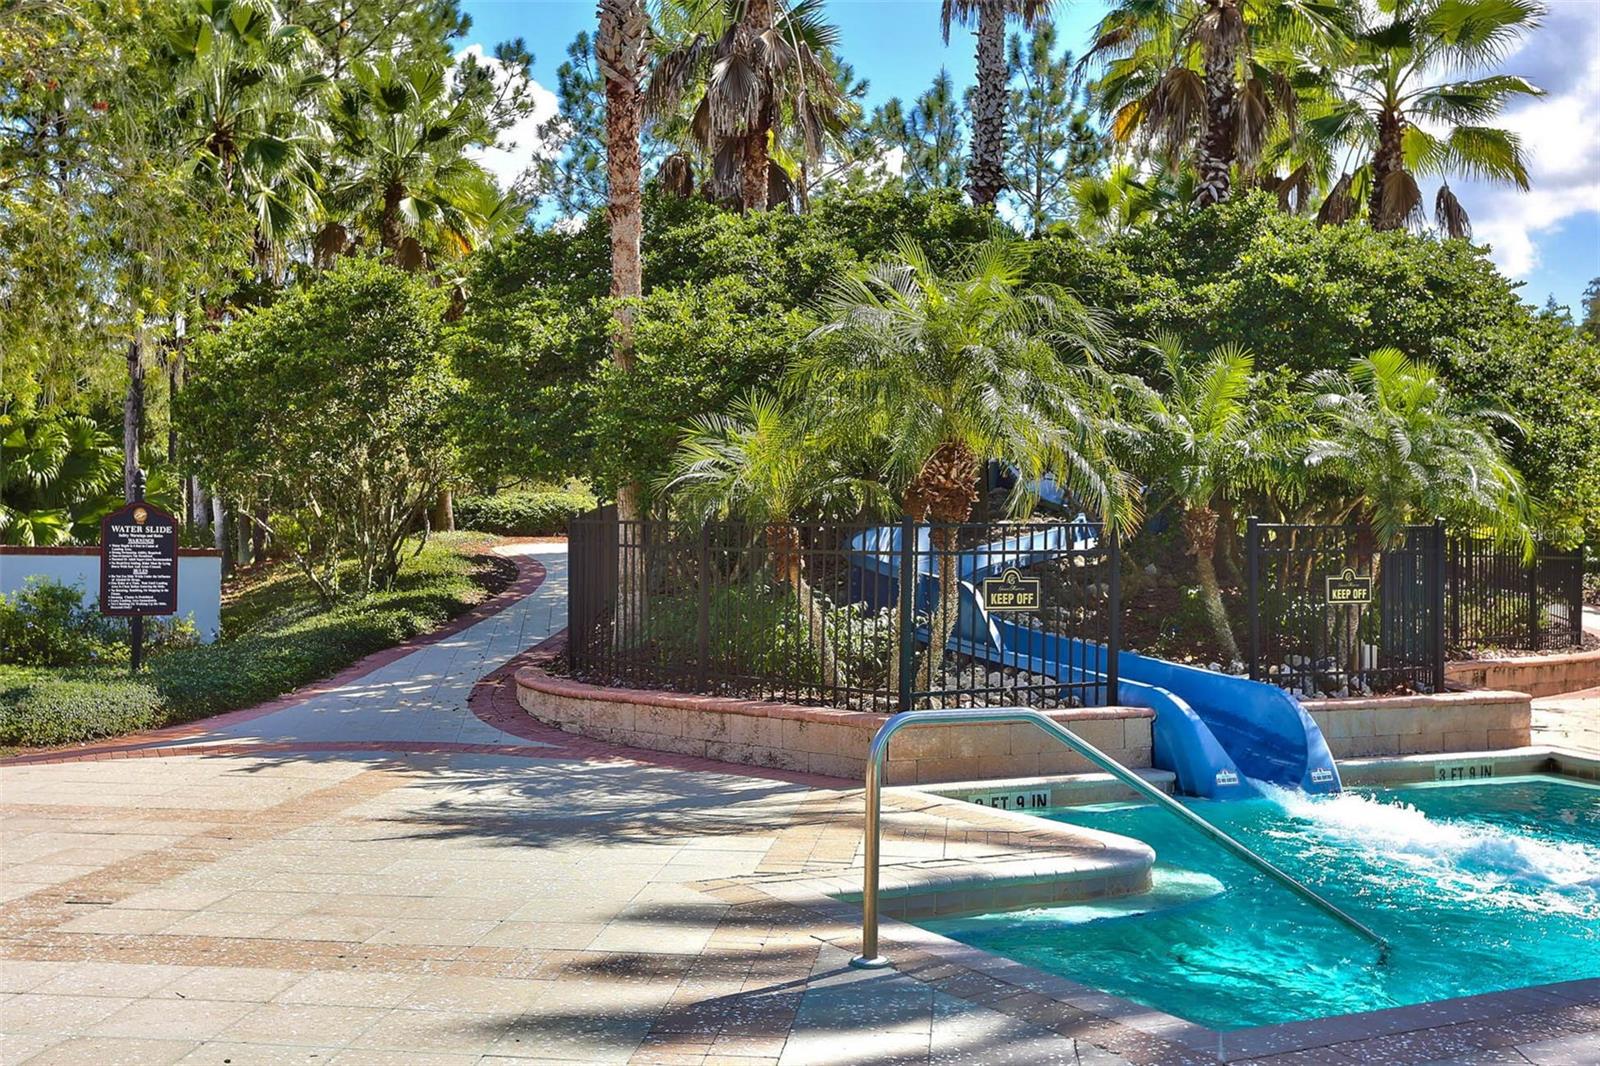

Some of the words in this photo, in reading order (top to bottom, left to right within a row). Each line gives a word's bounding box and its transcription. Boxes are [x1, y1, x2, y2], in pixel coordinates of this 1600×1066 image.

[111, 525, 143, 533] WATER
[145, 526, 173, 534] SLIDE
[990, 593, 1014, 605] KEEP
[1016, 592, 1034, 605] OFF
[1331, 588, 1352, 600] KEEP
[1352, 588, 1367, 600] OFF
[1451, 767, 1464, 781] FT
[1480, 765, 1492, 778] IN
[991, 796, 1009, 809] FT
[1016, 795, 1025, 808] 9
[1032, 793, 1047, 808] IN
